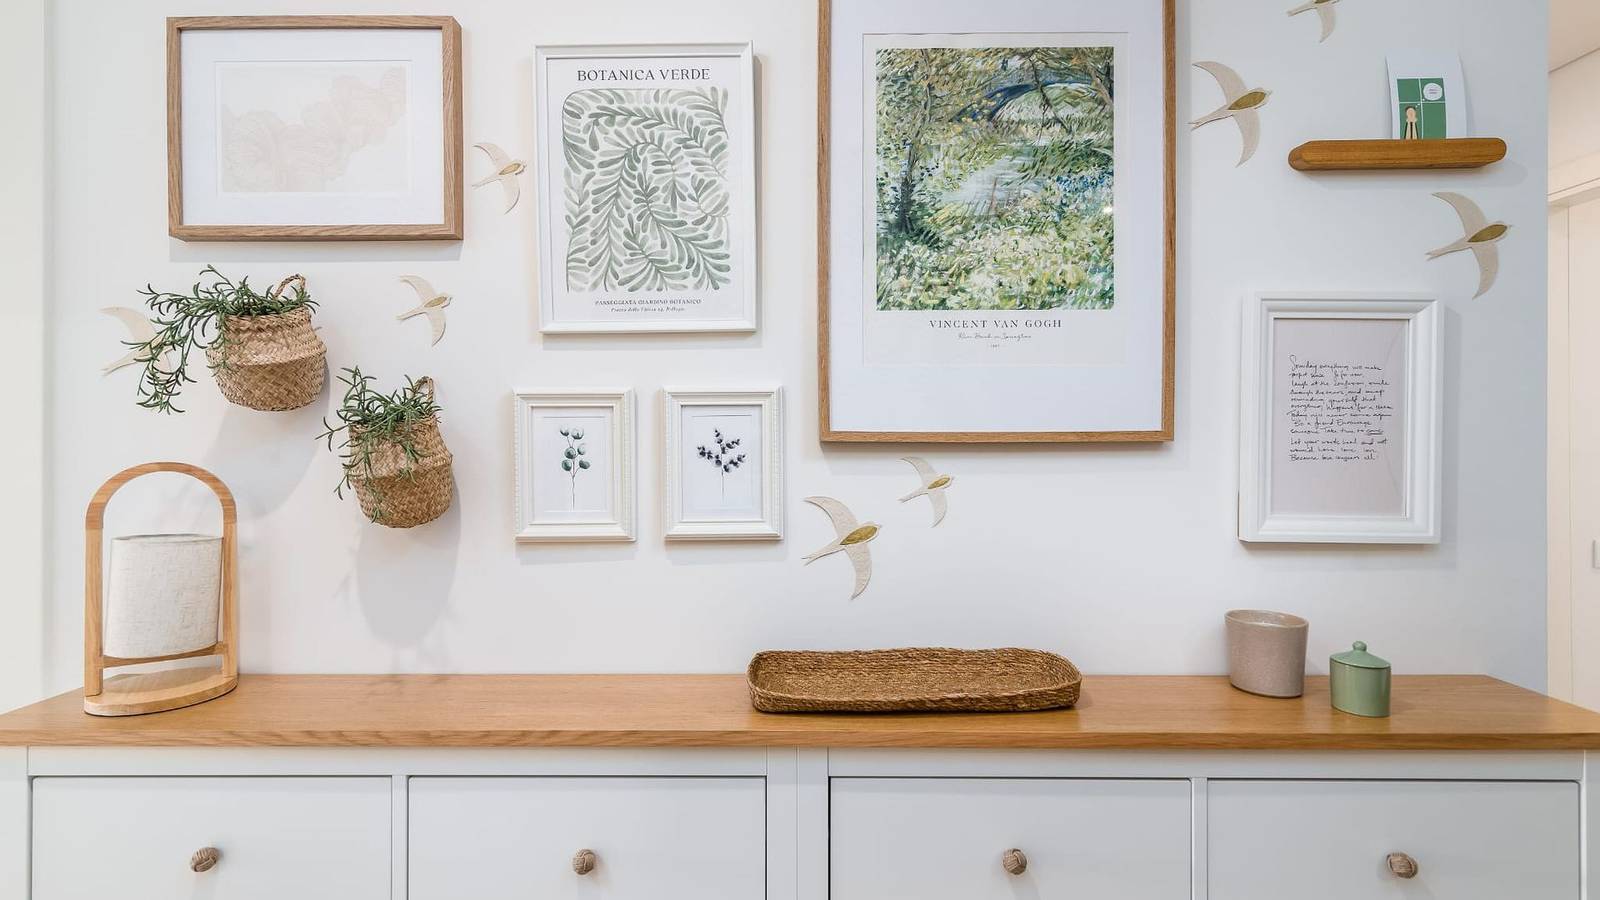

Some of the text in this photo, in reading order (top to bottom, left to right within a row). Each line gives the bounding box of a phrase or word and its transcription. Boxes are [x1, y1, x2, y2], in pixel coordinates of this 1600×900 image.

[577, 68, 710, 81] BOTANICA VERDE
[929, 319, 1062, 329] VINCENT VAN GOGH
